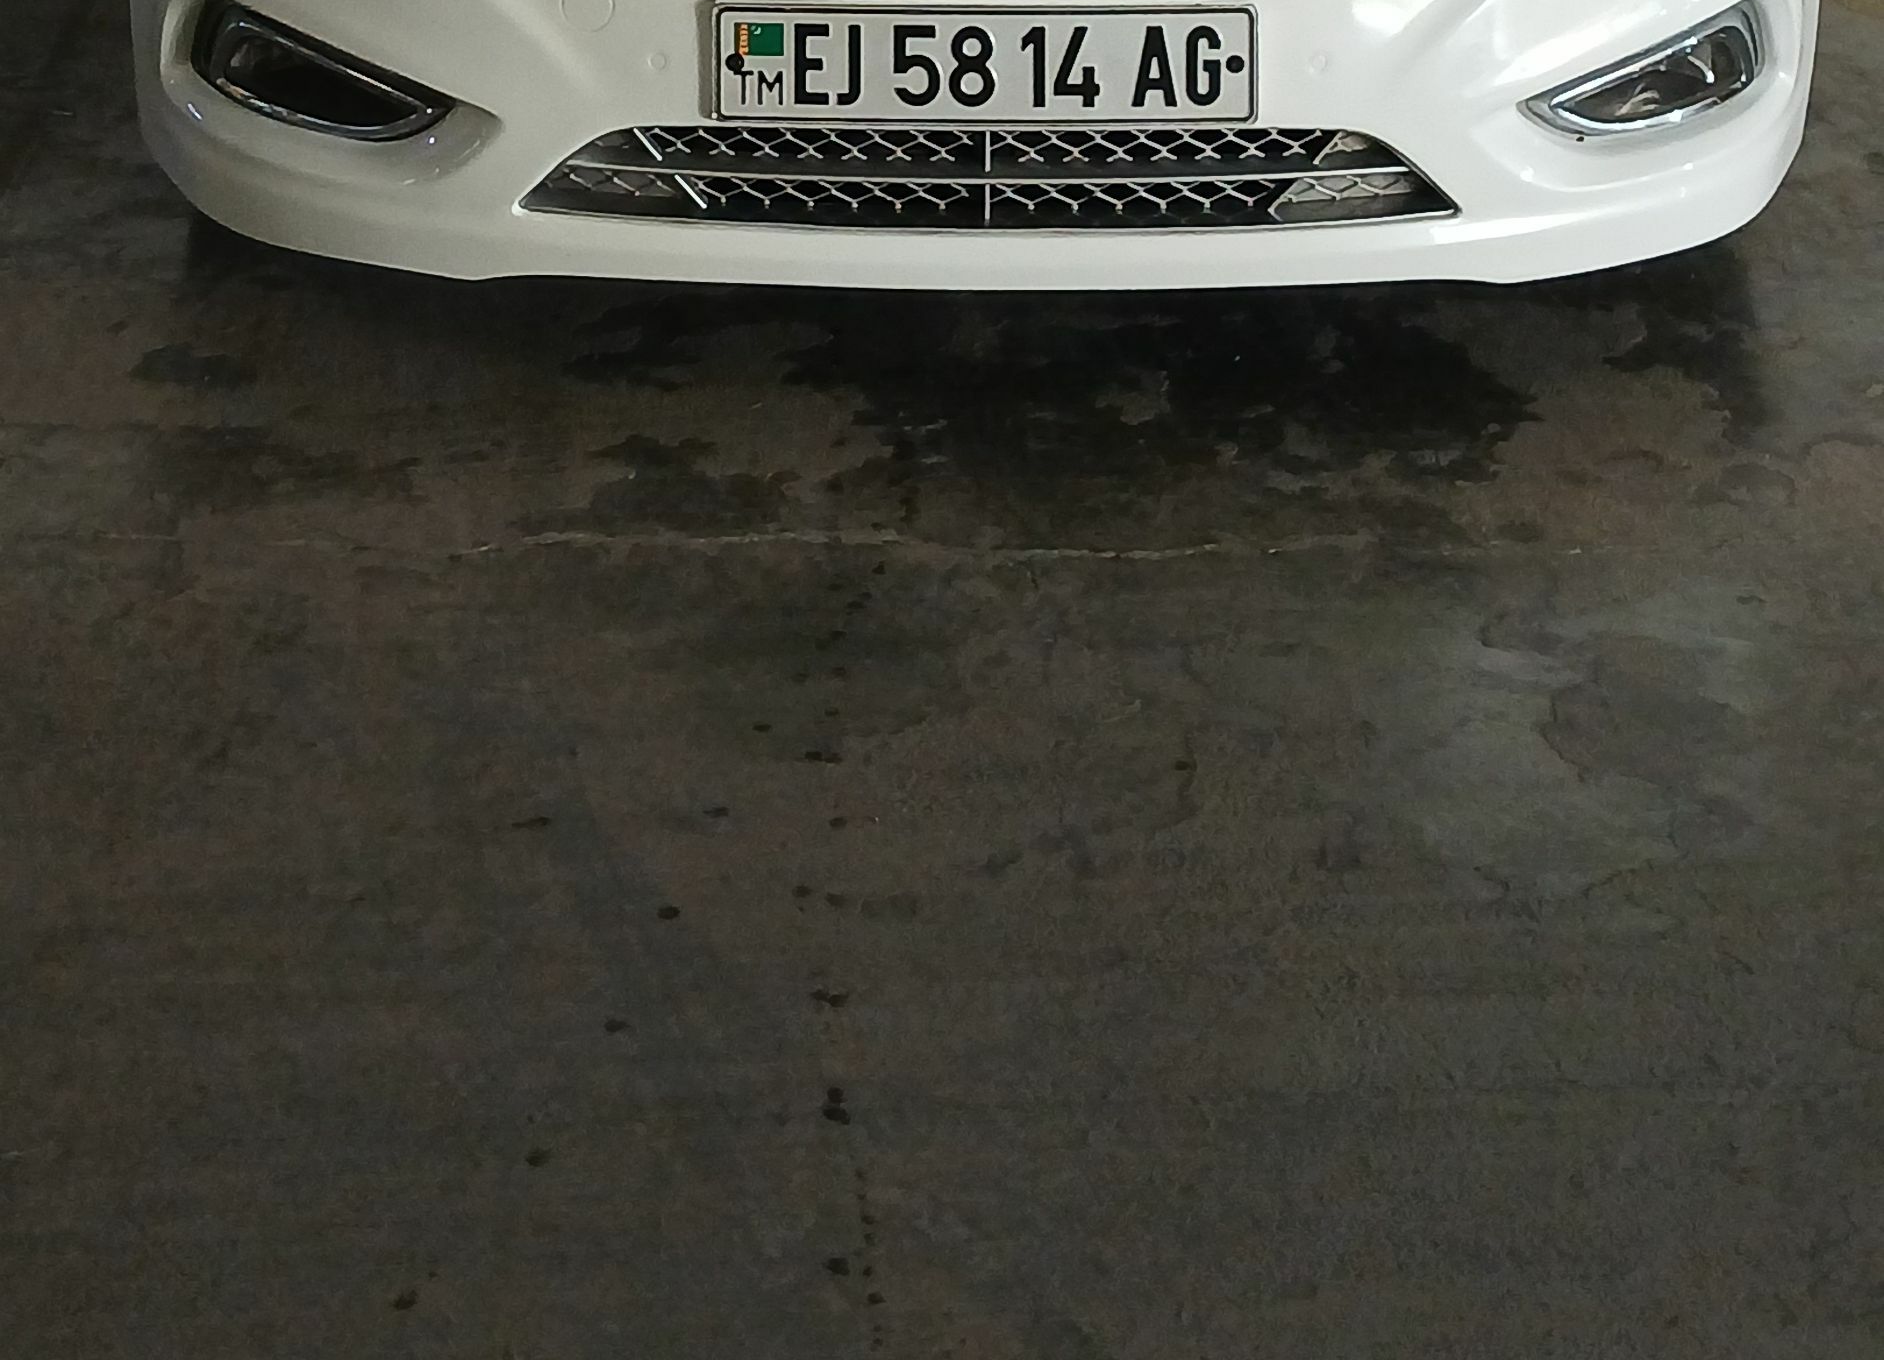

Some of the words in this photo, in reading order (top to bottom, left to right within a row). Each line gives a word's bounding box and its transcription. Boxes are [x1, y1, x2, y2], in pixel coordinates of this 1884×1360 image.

[733, 70, 784, 106] TM
[793, 22, 862, 106] EJ
[893, 24, 996, 108] 58
[1020, 25, 1101, 108] 14
[1131, 25, 1222, 108] AG
